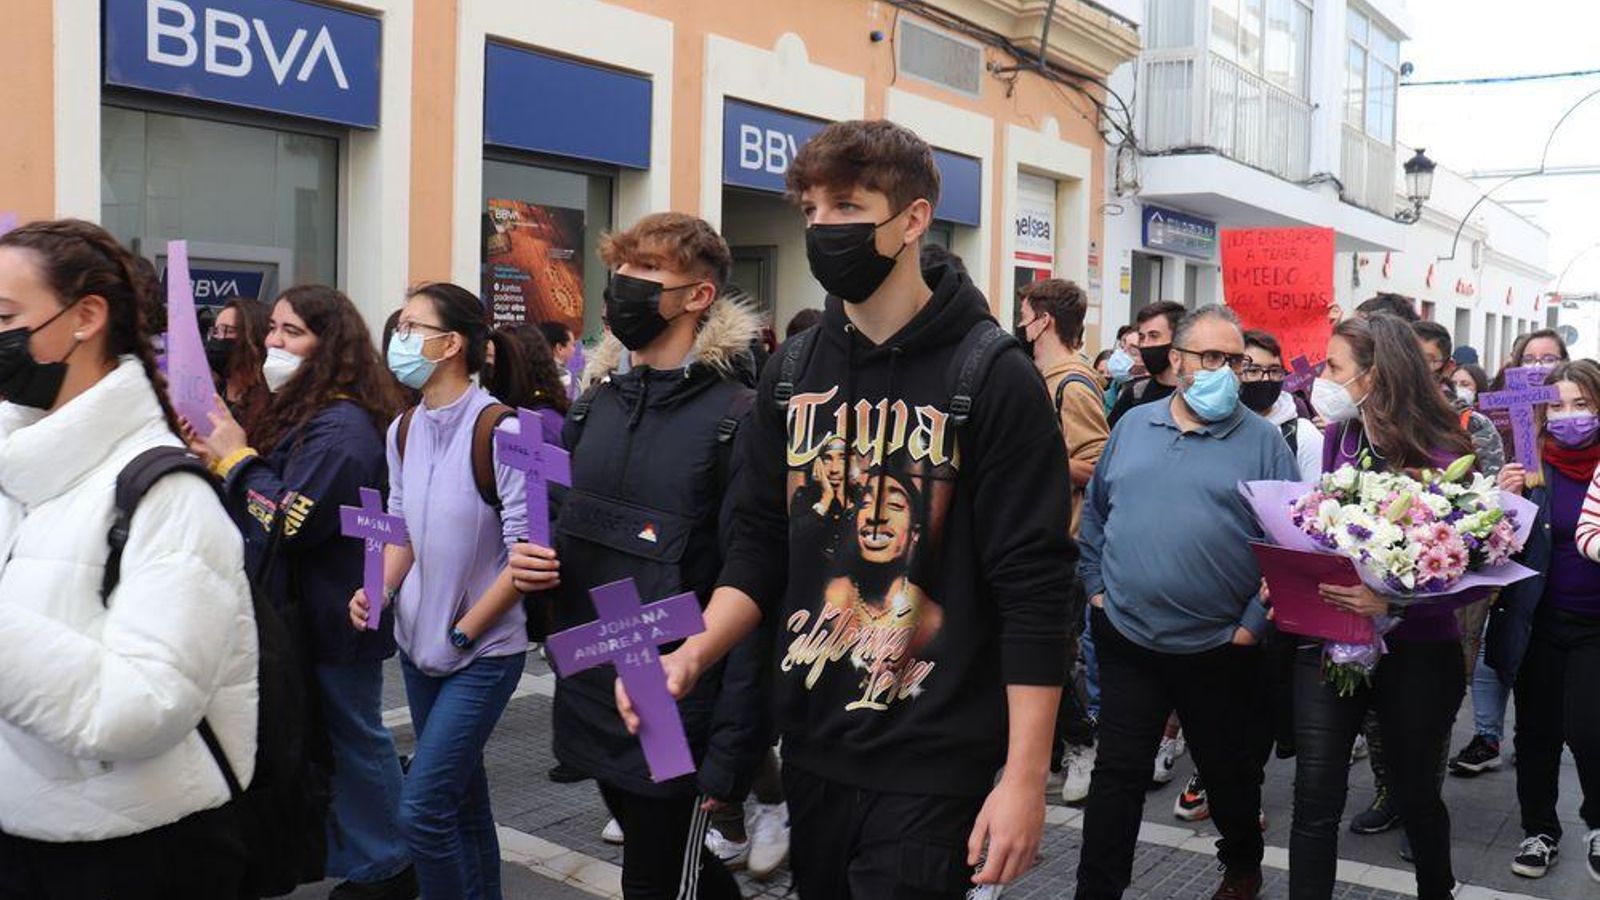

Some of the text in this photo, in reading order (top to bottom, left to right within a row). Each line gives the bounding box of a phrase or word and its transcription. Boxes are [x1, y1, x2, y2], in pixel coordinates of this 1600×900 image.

[147, 0, 349, 89] BBVA
[191, 279, 239, 297] BVA
[1267, 290, 1329, 311] BRUJAS
[597, 608, 669, 637] JOHANA
[574, 632, 643, 661] ANDREA
[625, 647, 653, 667] 41
